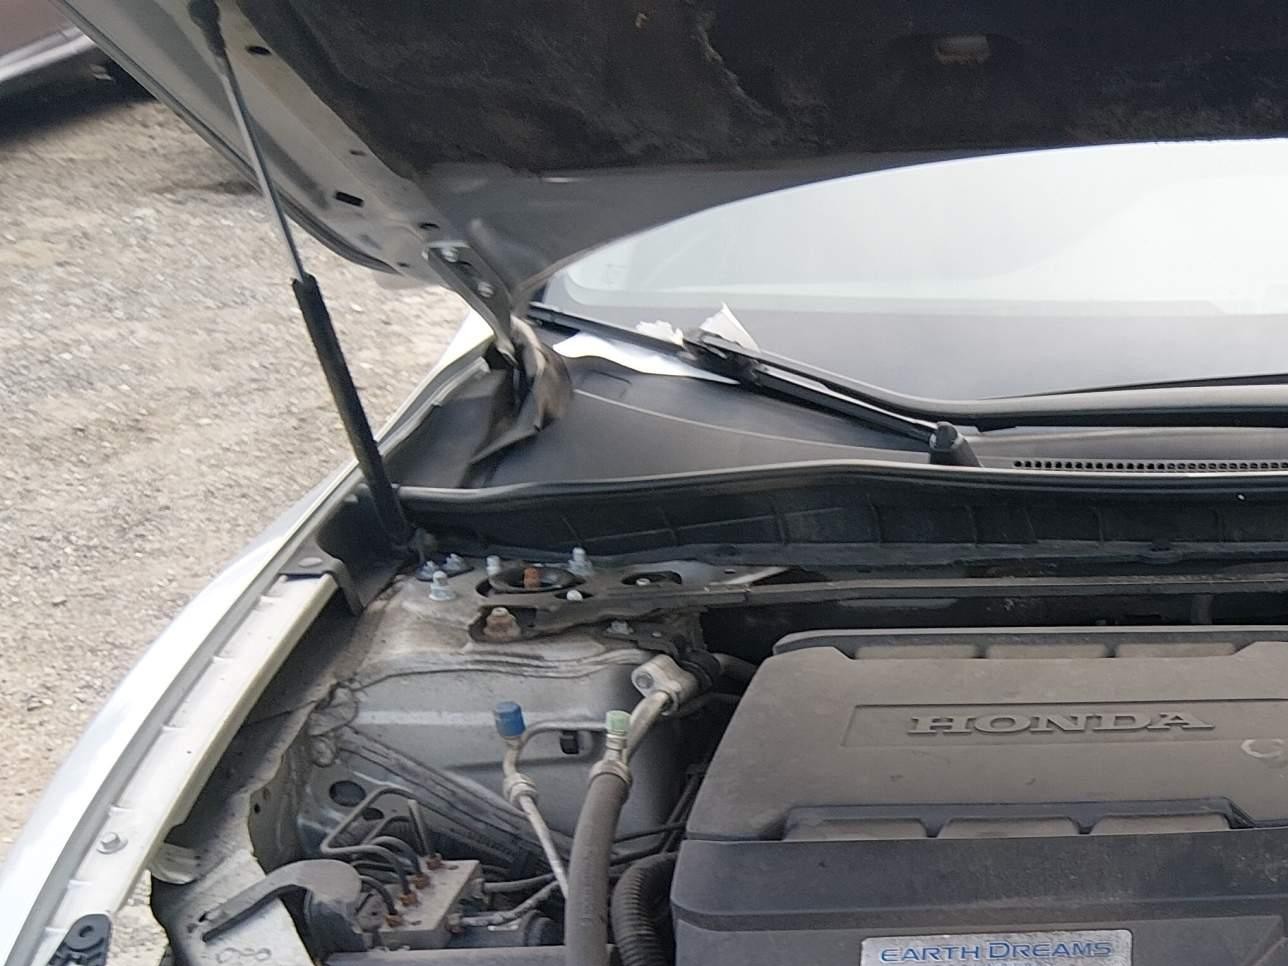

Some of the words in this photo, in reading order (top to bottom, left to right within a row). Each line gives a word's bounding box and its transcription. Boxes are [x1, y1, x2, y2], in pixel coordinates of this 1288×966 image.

[907, 711, 1216, 736] HONDA
[881, 946, 980, 962] EARTH
[988, 941, 1112, 959] DREAMS
